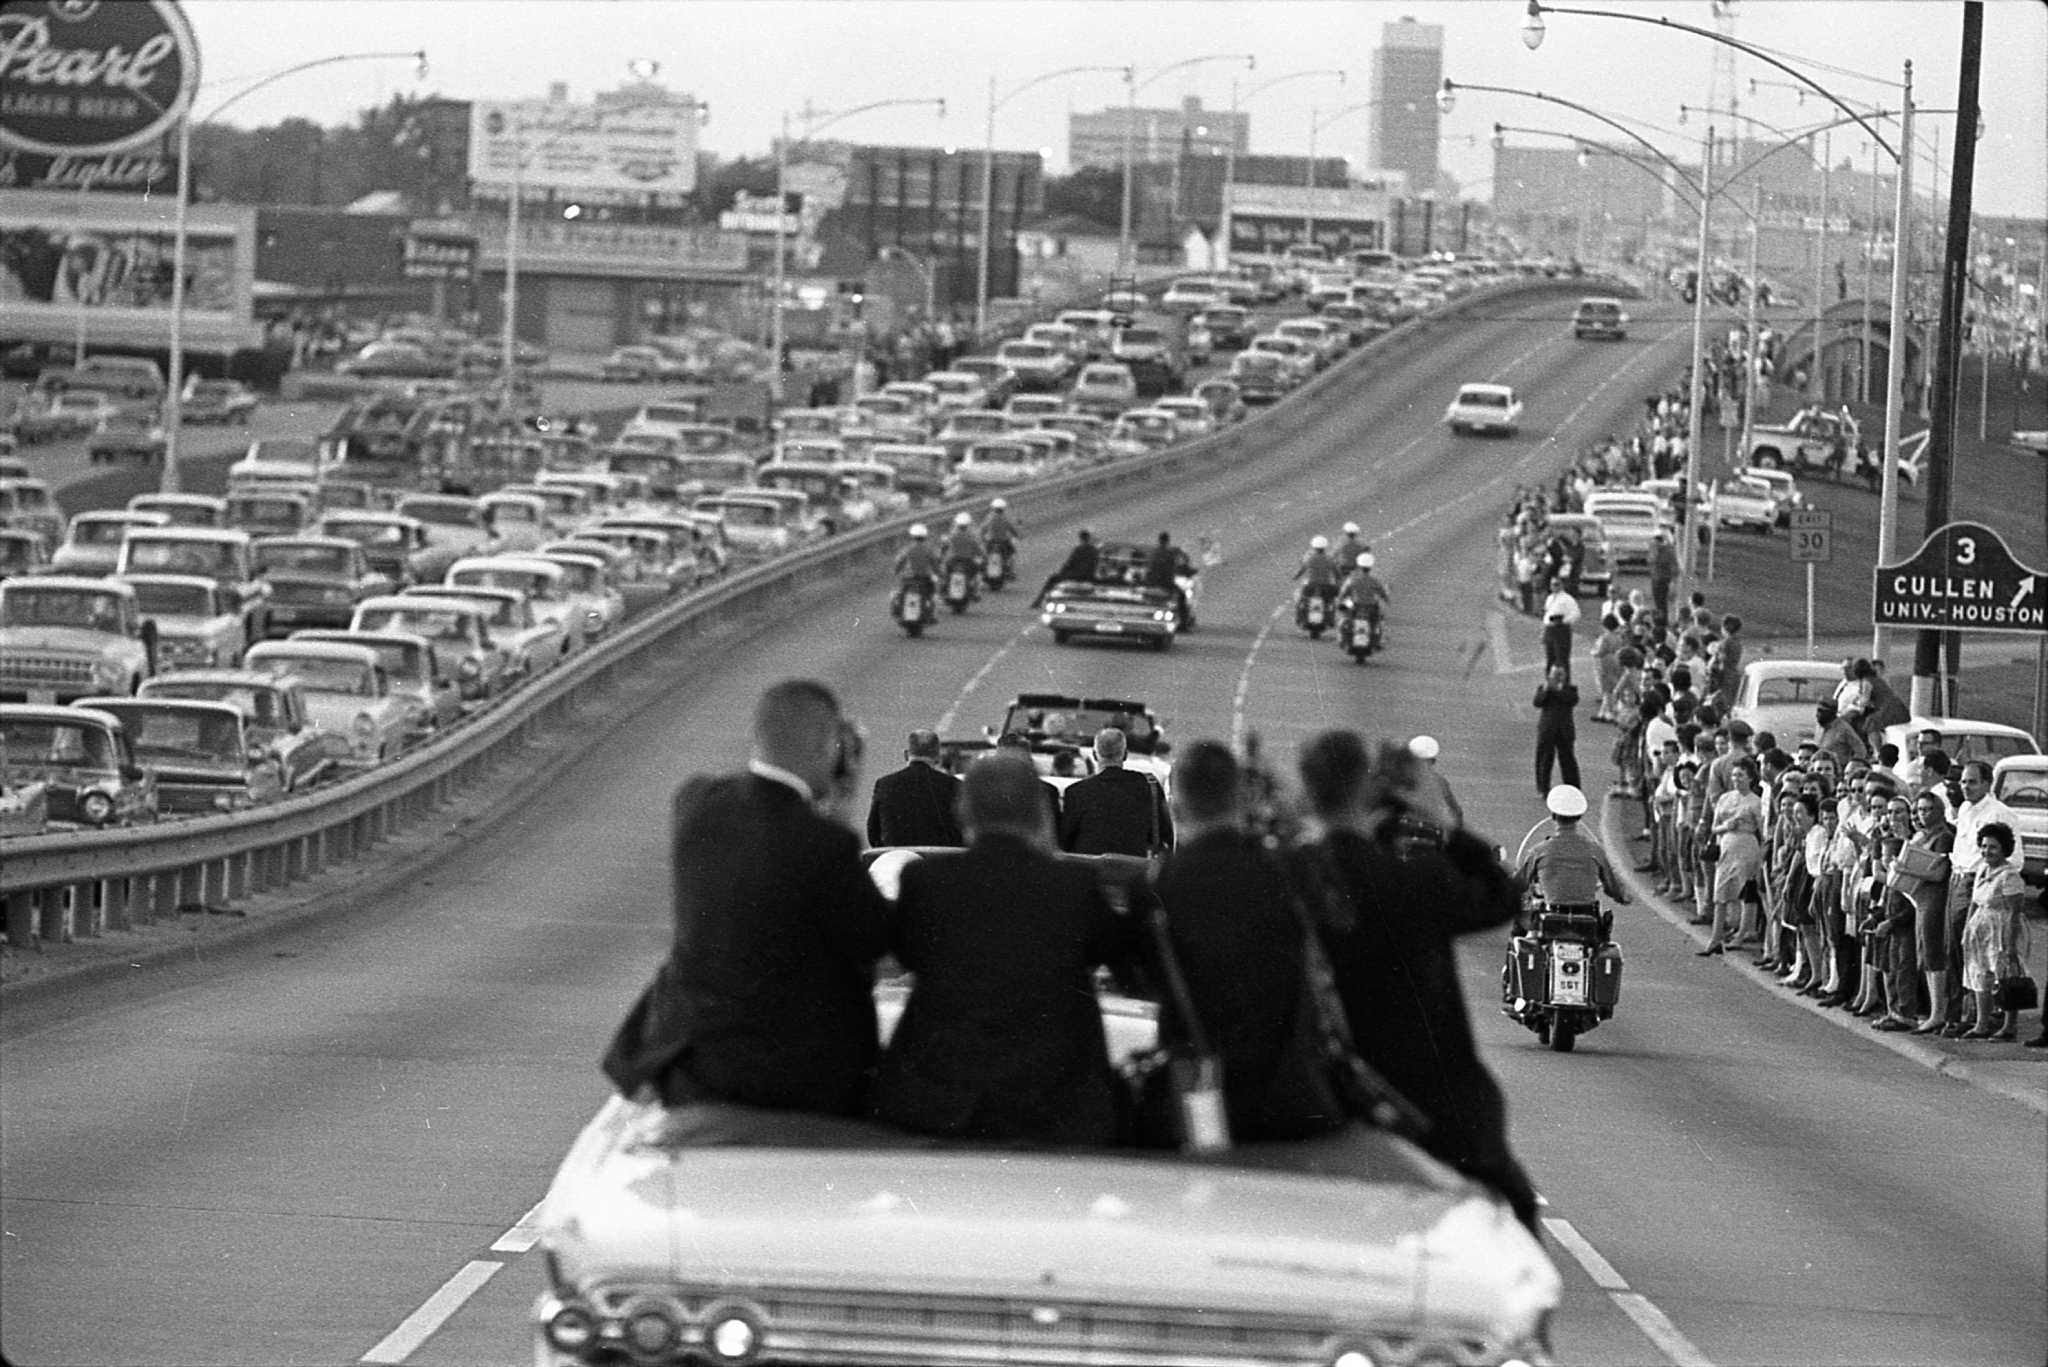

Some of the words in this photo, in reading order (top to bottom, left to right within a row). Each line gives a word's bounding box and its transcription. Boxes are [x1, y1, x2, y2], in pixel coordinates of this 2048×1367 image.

[0, 13, 174, 87] Pearl
[1798, 532, 1823, 549] 30
[1956, 537, 1976, 564] 3
[1894, 575, 1994, 599] CULLEN
